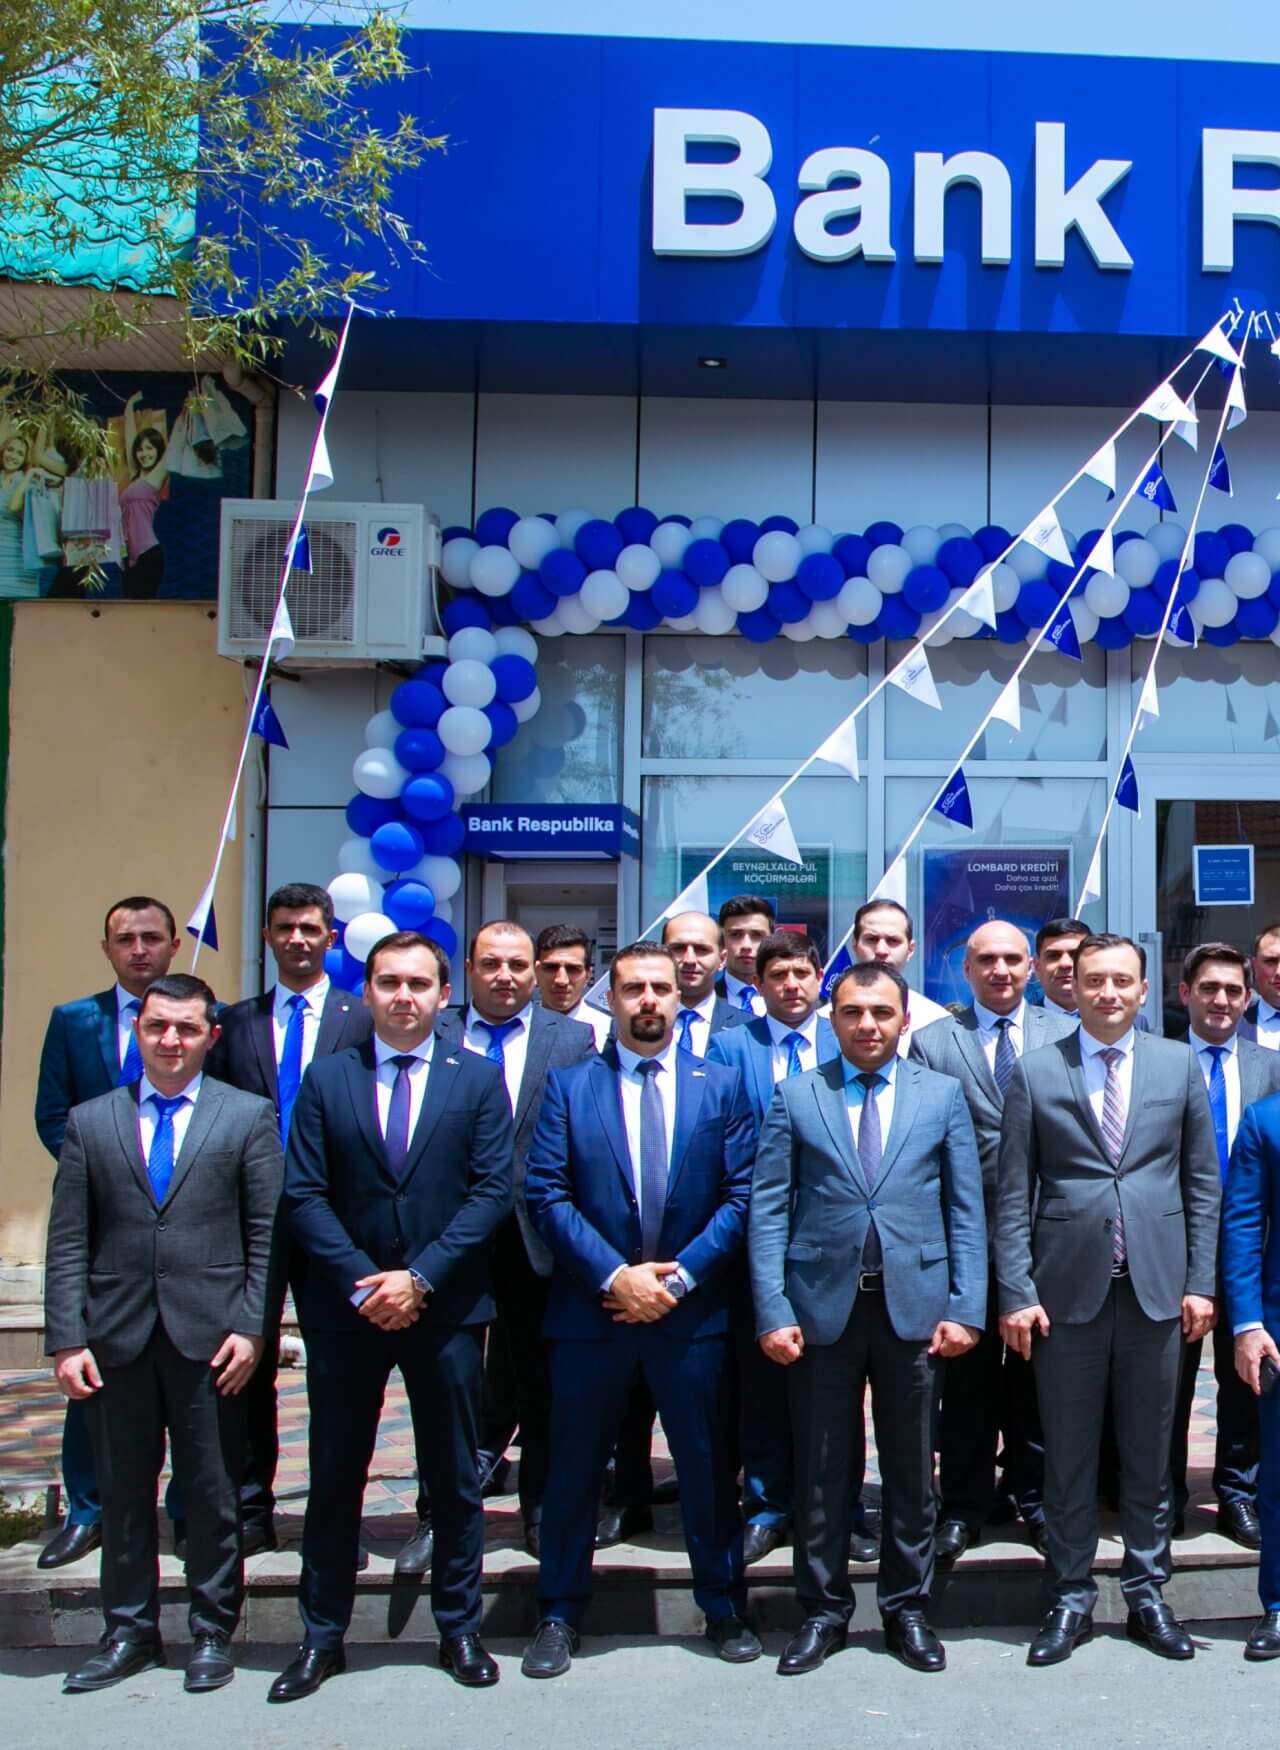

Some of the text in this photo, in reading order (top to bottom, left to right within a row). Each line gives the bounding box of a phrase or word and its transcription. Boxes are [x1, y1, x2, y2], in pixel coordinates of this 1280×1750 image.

[653, 107, 1134, 270] Bank
[370, 547, 407, 557] GREE
[468, 817, 513, 832] Bank
[518, 817, 614, 835] Respublika
[799, 863, 817, 872] PUL
[968, 861, 1059, 872] LOMBARD KREDİTİ
[1006, 874, 1028, 882] Daha
[994, 883, 1016, 891] Daha
